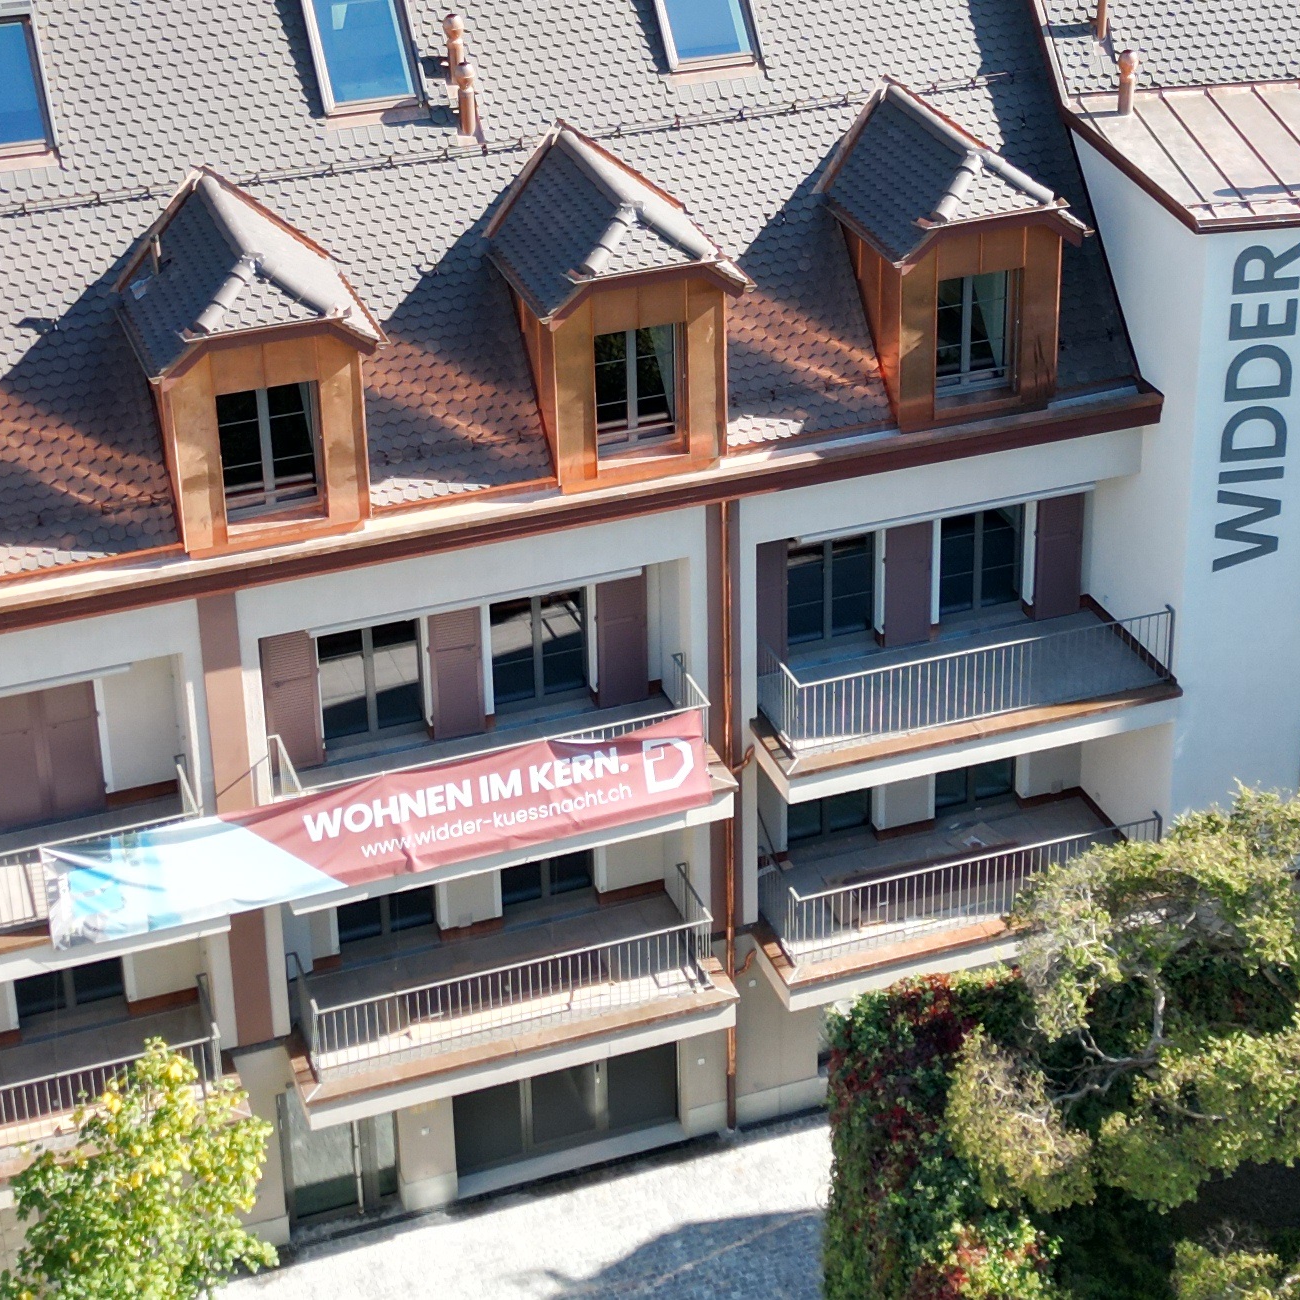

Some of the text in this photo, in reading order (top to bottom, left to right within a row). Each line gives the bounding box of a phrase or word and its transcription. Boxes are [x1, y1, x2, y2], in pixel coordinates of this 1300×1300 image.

[302, 747, 630, 843] WOHNEN IM KERN.
[361, 783, 633, 858] www.widder-kuessnacht.ch
